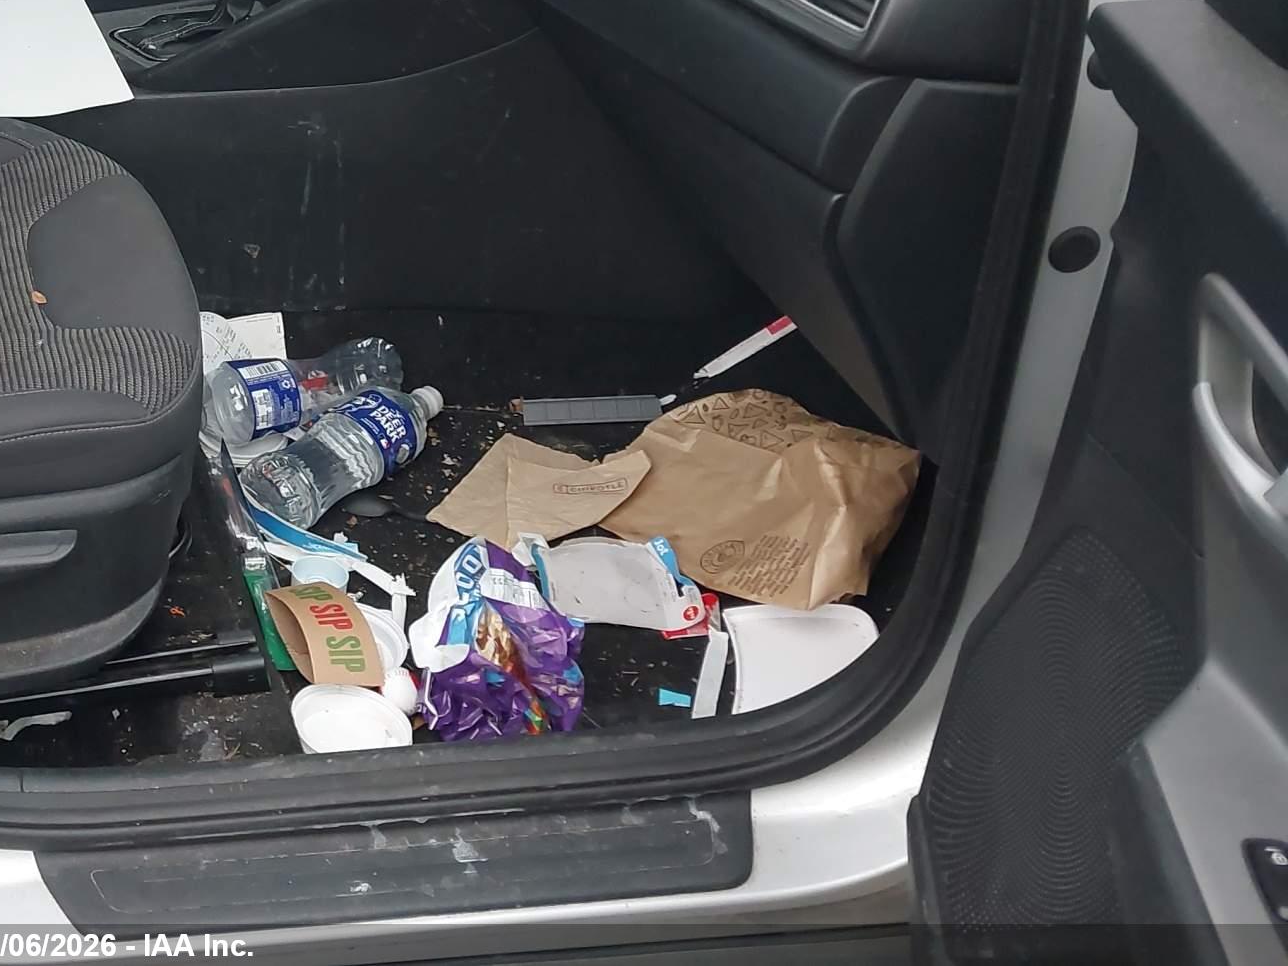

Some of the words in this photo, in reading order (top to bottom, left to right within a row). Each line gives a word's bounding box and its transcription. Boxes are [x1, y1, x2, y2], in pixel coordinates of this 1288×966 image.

[369, 410, 400, 444] PARK
[378, 405, 407, 438] DEER
[309, 603, 354, 630] SIP
[326, 635, 366, 673] SIP
